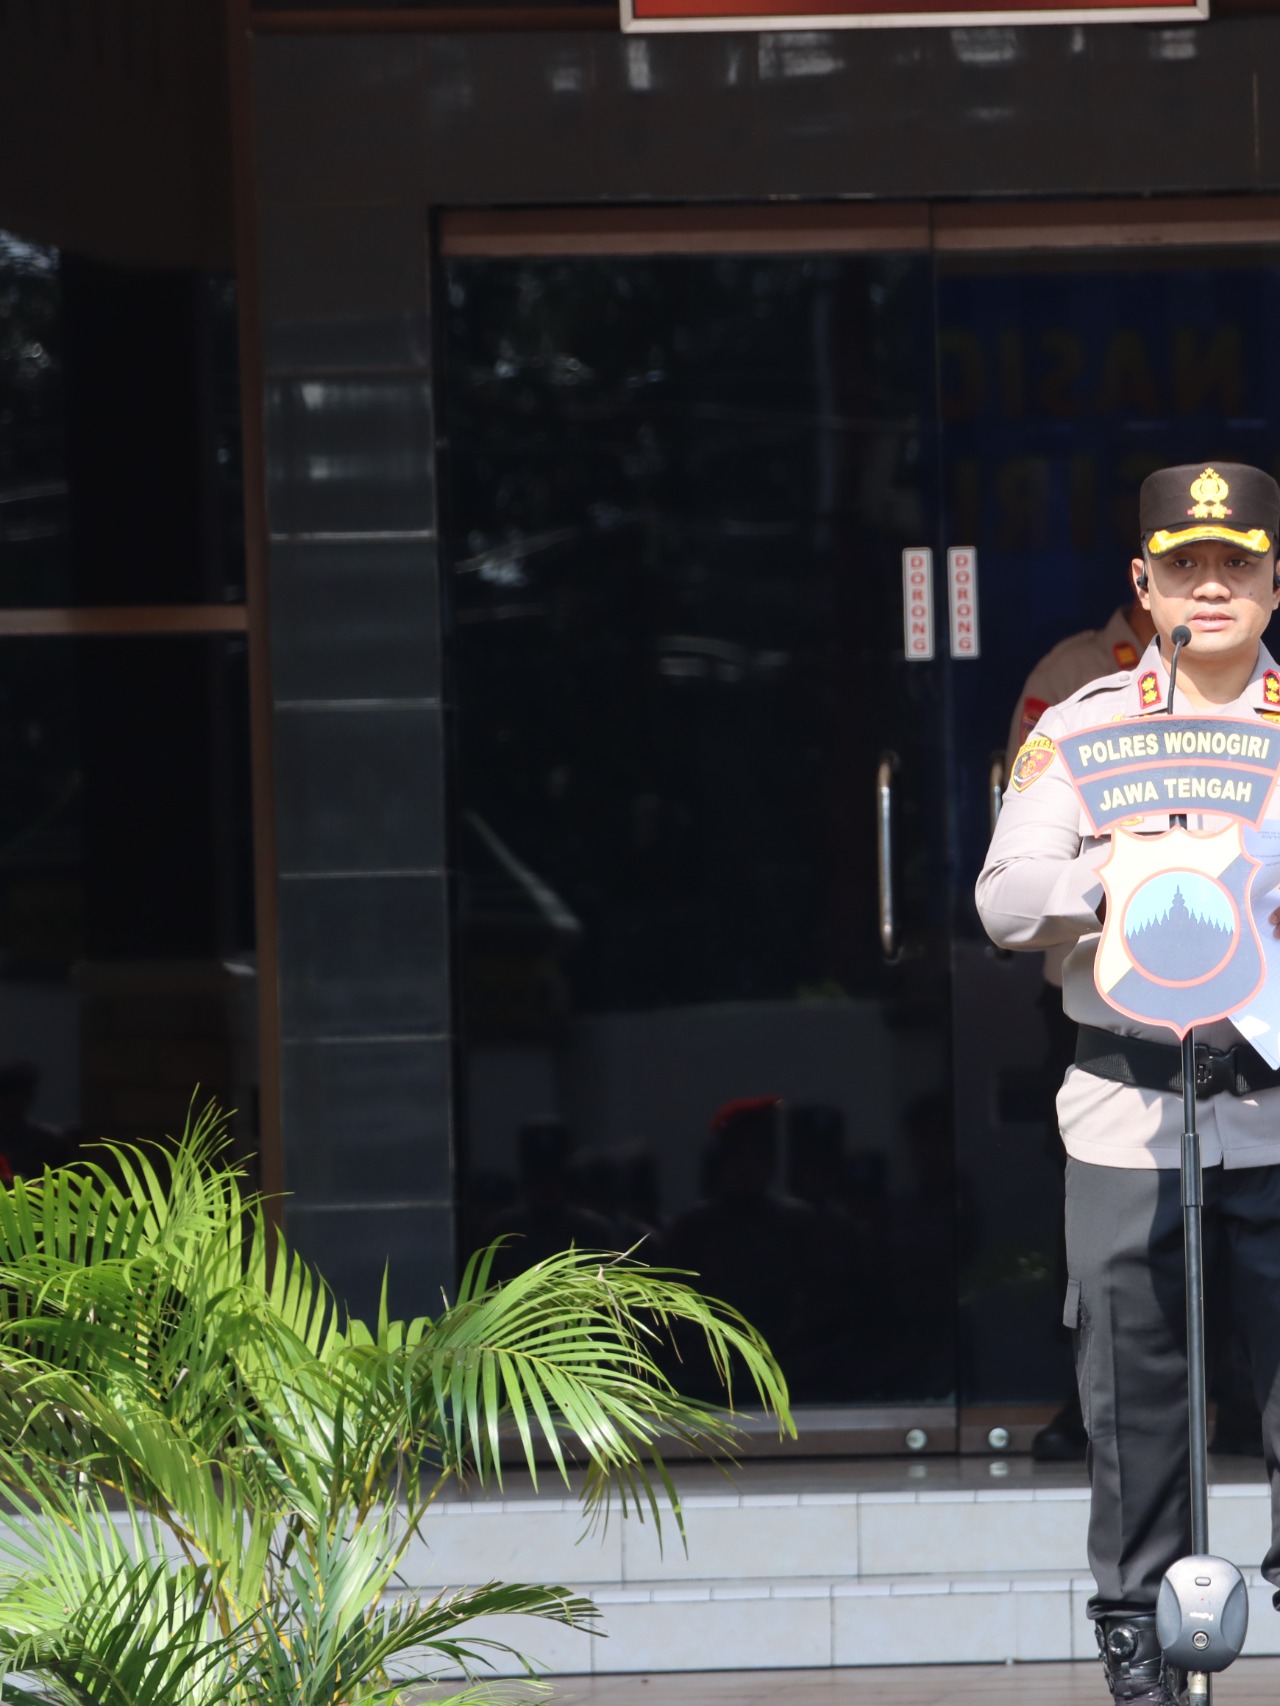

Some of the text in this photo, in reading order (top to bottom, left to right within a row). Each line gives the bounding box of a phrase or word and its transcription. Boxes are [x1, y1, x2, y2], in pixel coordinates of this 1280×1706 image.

[910, 555, 926, 653] DORONG
[955, 554, 972, 651] DORONG
[1078, 733, 1159, 767] POLRES
[1163, 731, 1270, 760] WONOGIRI
[1100, 777, 1252, 811] JAWA TENGAH
